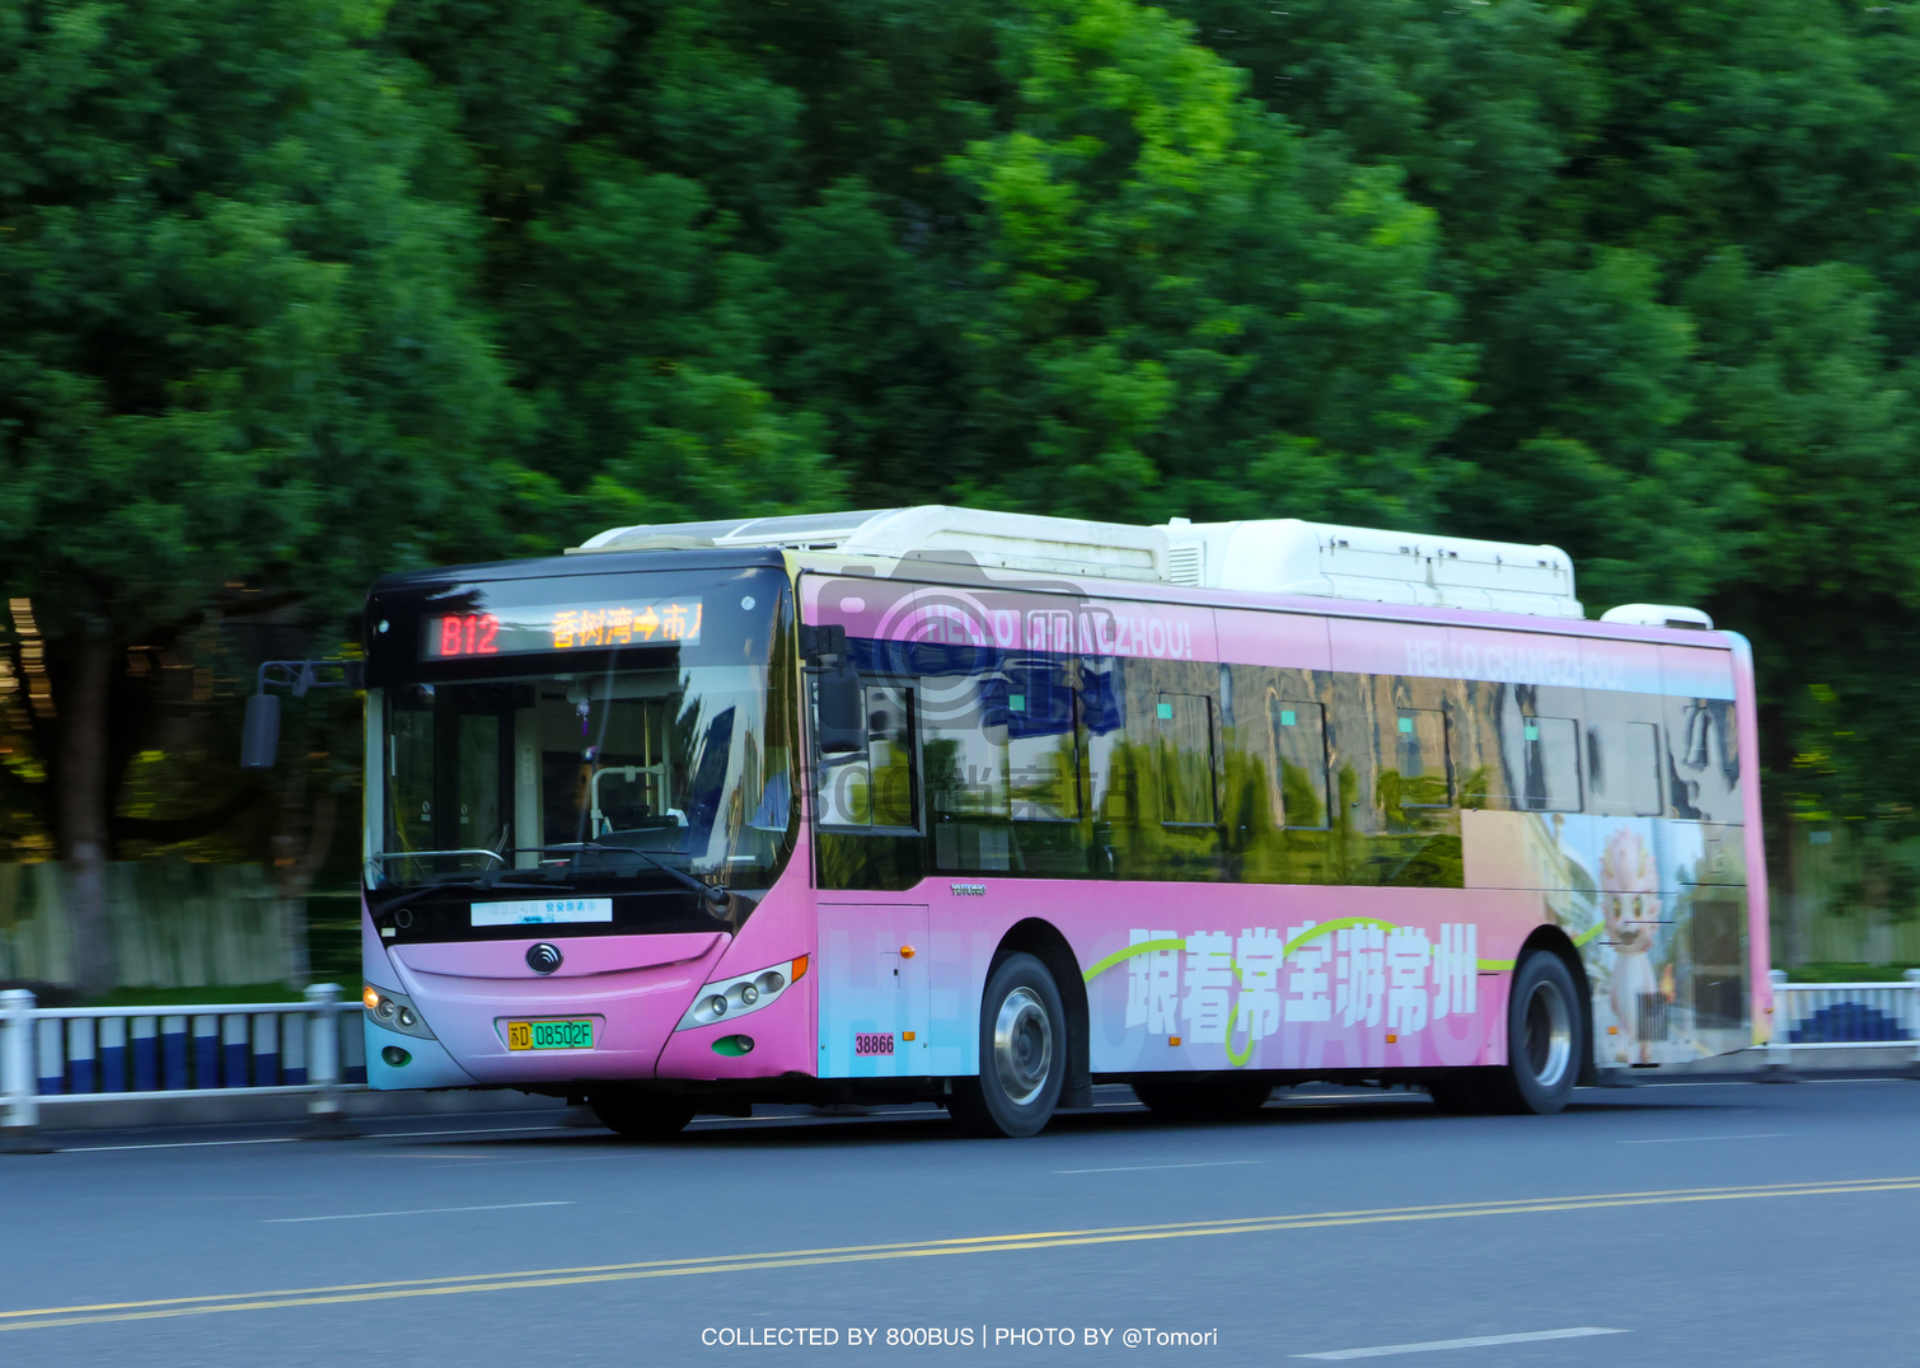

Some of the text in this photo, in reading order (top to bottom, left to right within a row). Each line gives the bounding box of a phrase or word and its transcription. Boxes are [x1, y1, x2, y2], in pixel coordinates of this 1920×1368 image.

[440, 614, 498, 656] B12
[552, 607, 633, 648] 香树湾
[925, 603, 1193, 659] HELLO CHANGZHOU!
[1404, 638, 1478, 680] HELLO
[1125, 920, 1477, 1044] 跟着常宝游常州
[536, 1024, 590, 1046] 08502F
[856, 1035, 894, 1054] 38866
